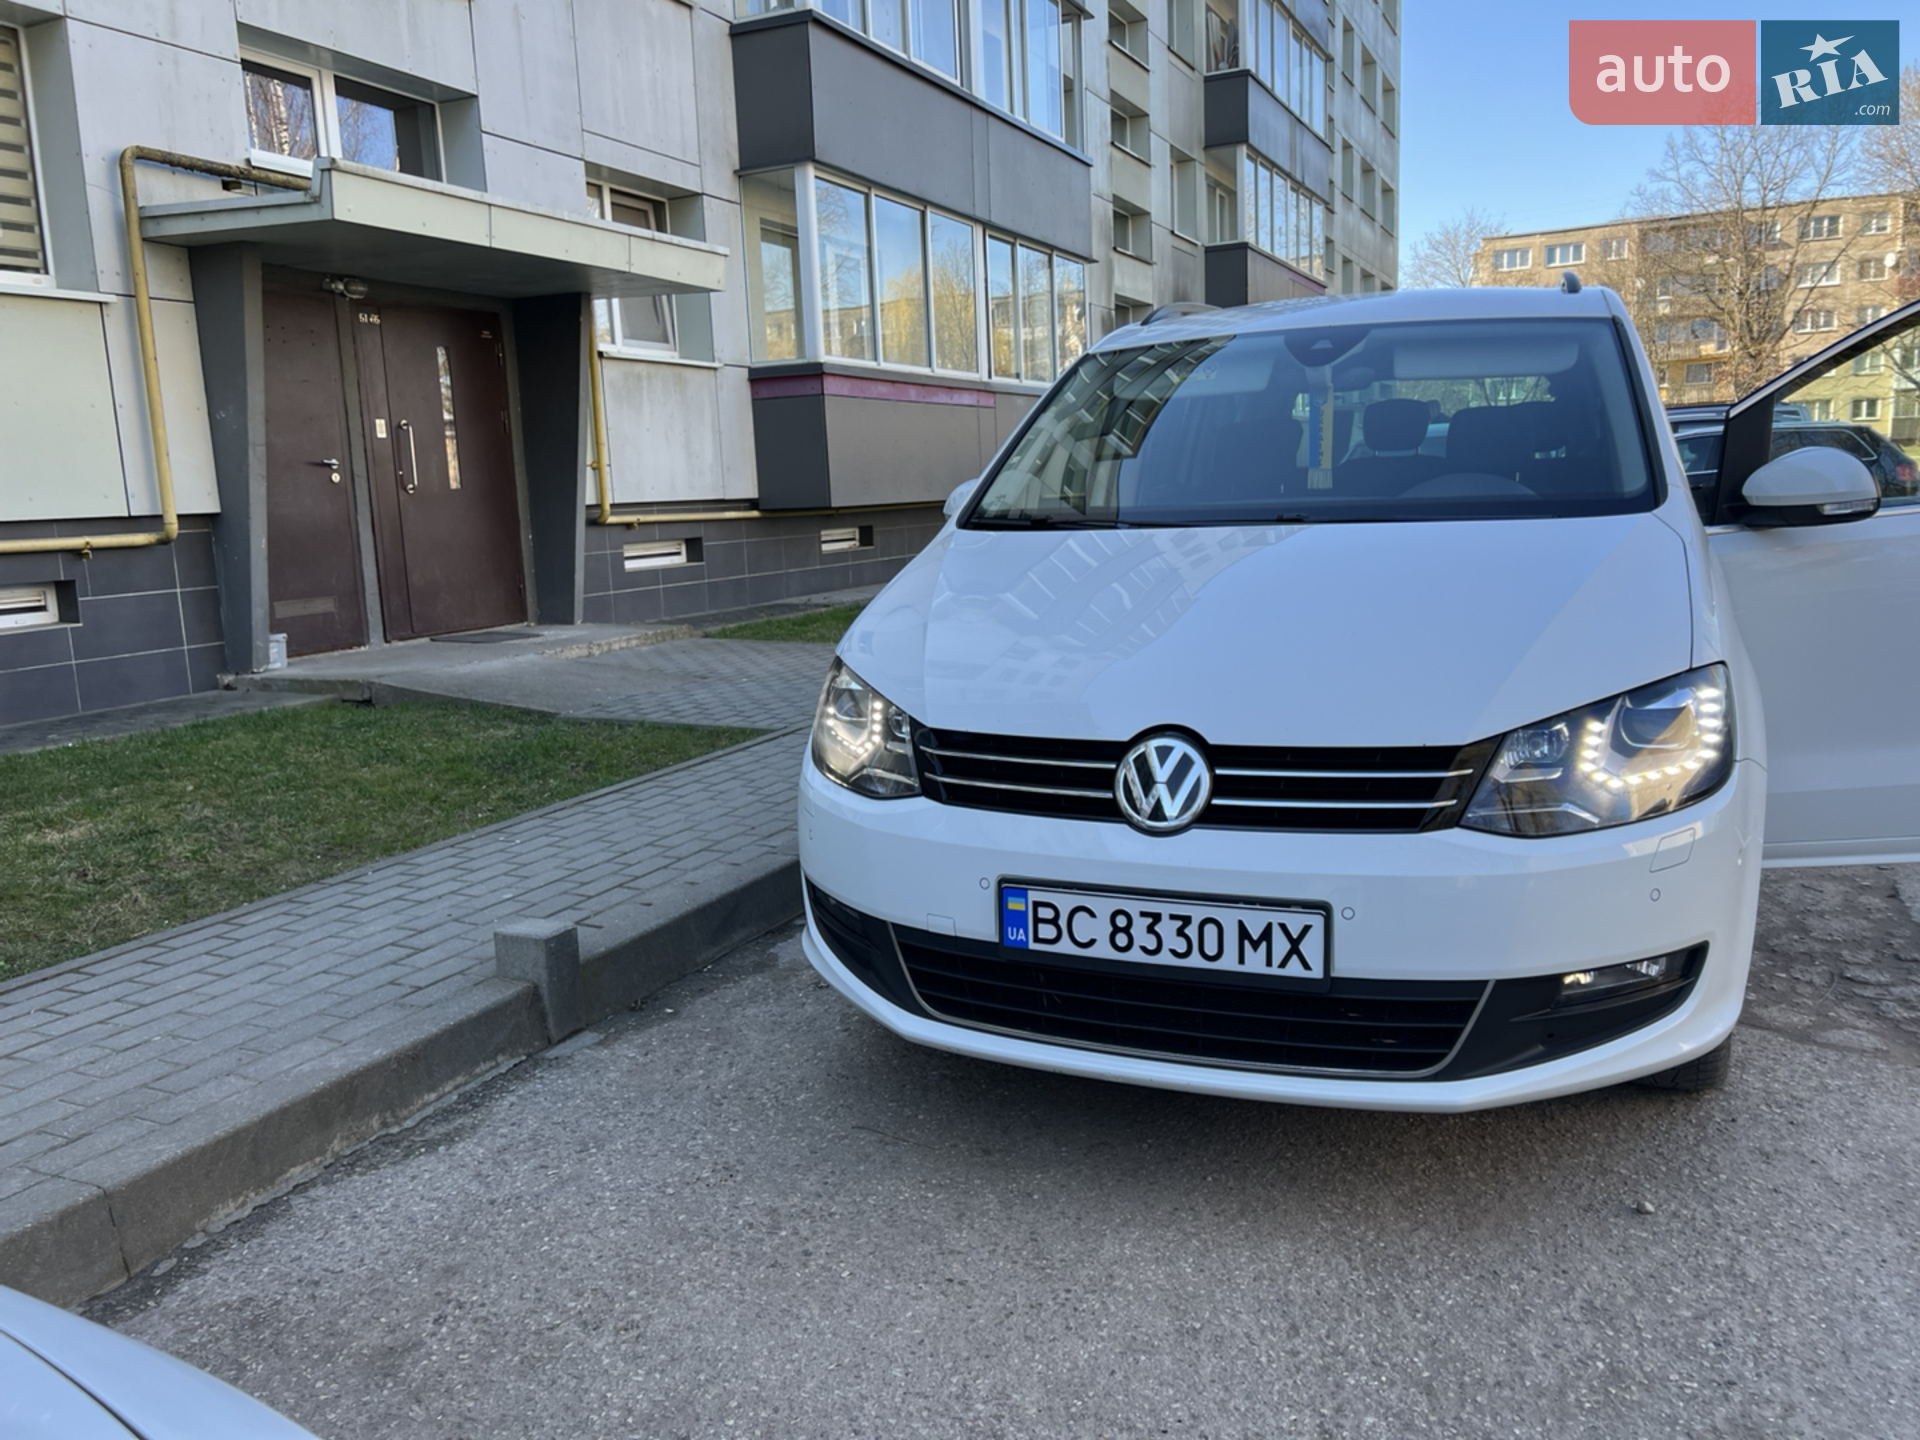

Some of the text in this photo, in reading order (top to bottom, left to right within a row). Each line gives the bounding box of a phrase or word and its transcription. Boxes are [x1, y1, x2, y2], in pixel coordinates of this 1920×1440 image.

[1008, 926, 1026, 942] UA
[1031, 900, 1314, 971] BC 8330 MX
